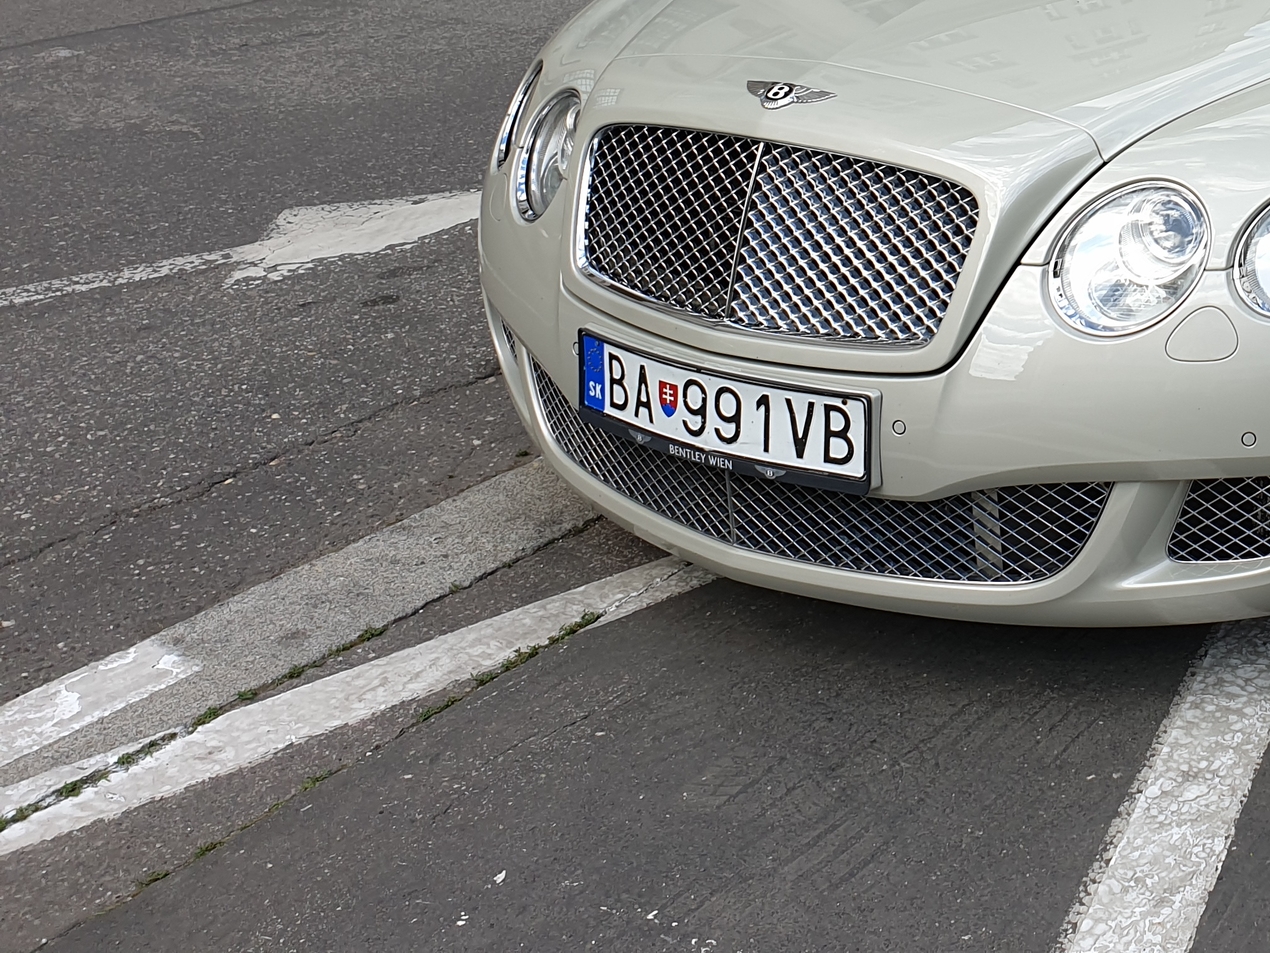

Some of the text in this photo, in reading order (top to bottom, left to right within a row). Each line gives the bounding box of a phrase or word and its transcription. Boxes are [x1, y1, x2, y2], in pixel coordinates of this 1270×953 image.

[589, 380, 602, 399] SK
[608, 351, 854, 466] BA 991VB
[669, 444, 733, 470] BENTLEY WIEN
